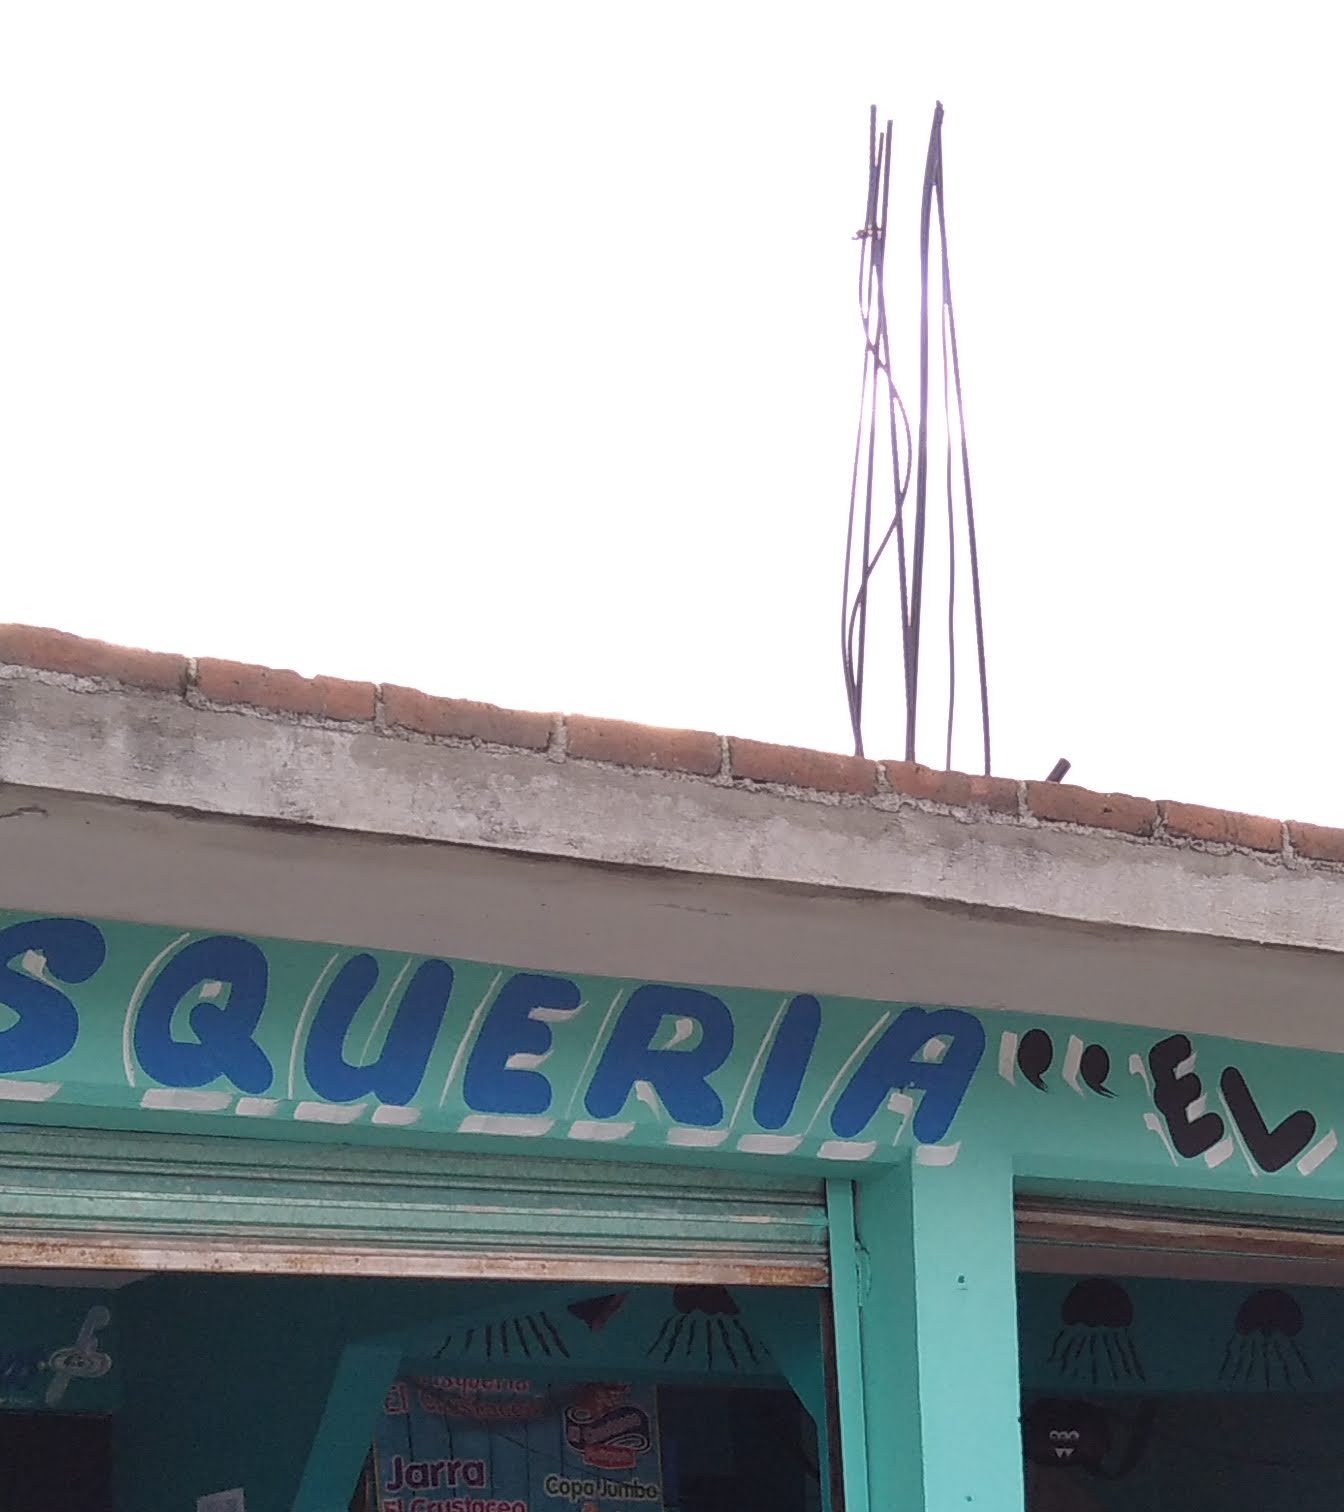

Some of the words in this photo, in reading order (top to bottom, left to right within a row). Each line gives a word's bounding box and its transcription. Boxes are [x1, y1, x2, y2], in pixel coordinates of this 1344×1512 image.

[385, 1455, 487, 1492] Jarra
[544, 1475, 595, 1503] Copa
[598, 1476, 660, 1499] Jumbo
